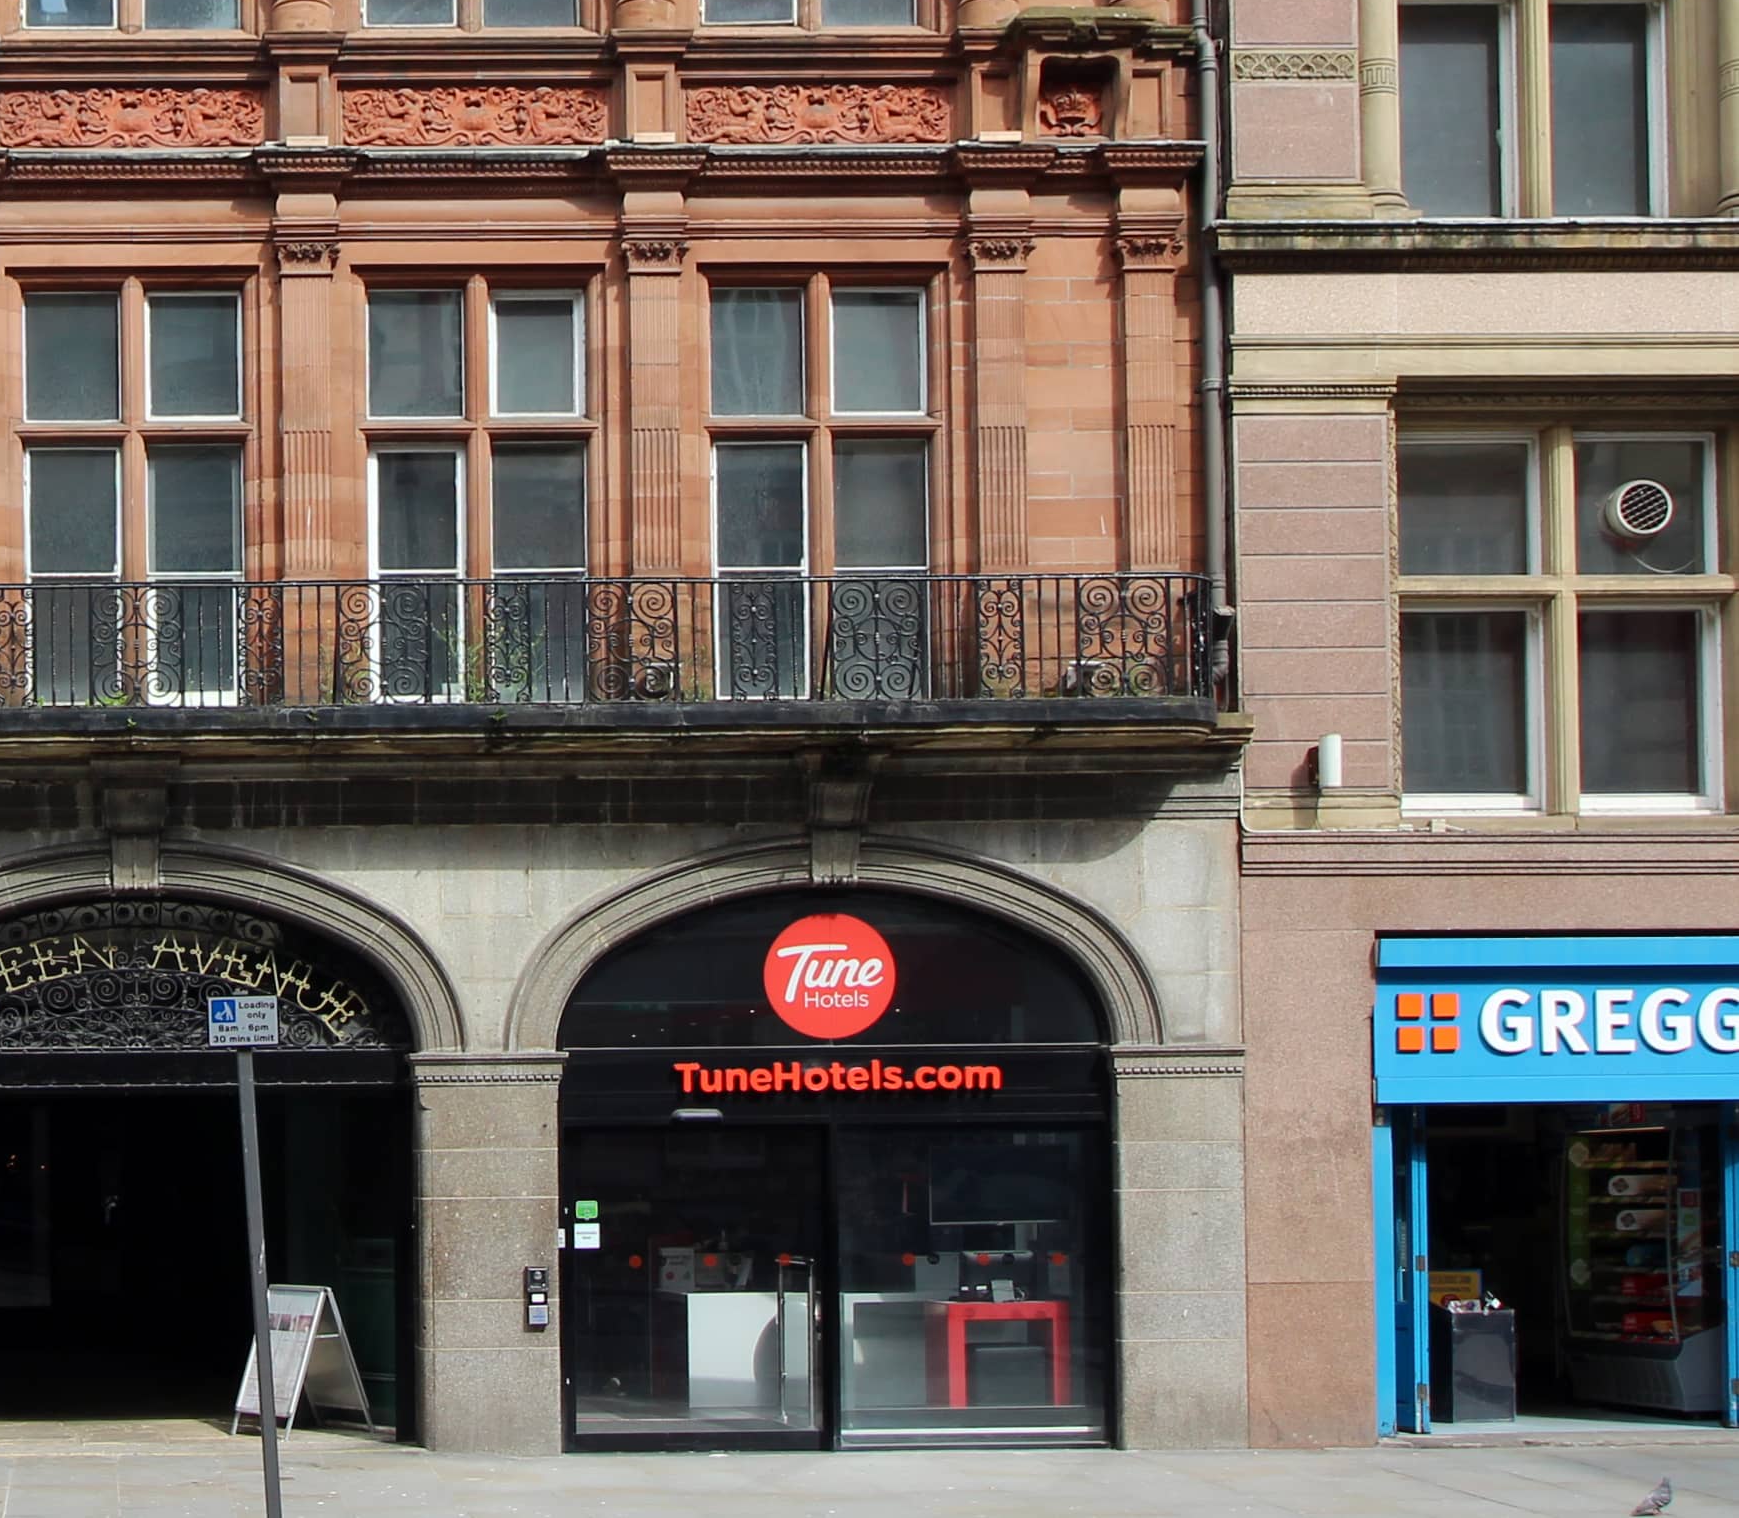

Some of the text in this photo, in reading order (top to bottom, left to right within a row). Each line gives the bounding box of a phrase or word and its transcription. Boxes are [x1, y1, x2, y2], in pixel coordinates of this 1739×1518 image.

[777, 943, 883, 1003] Tune
[146, 931, 370, 1042] AVENUE
[238, 1001, 275, 1009] Loading
[804, 990, 869, 1009] Hotels
[218, 1024, 239, 1032] 8am
[248, 1024, 269, 1032] 6pm
[213, 1035, 226, 1043] 30
[673, 1059, 1002, 1093] TuneHotels.com
